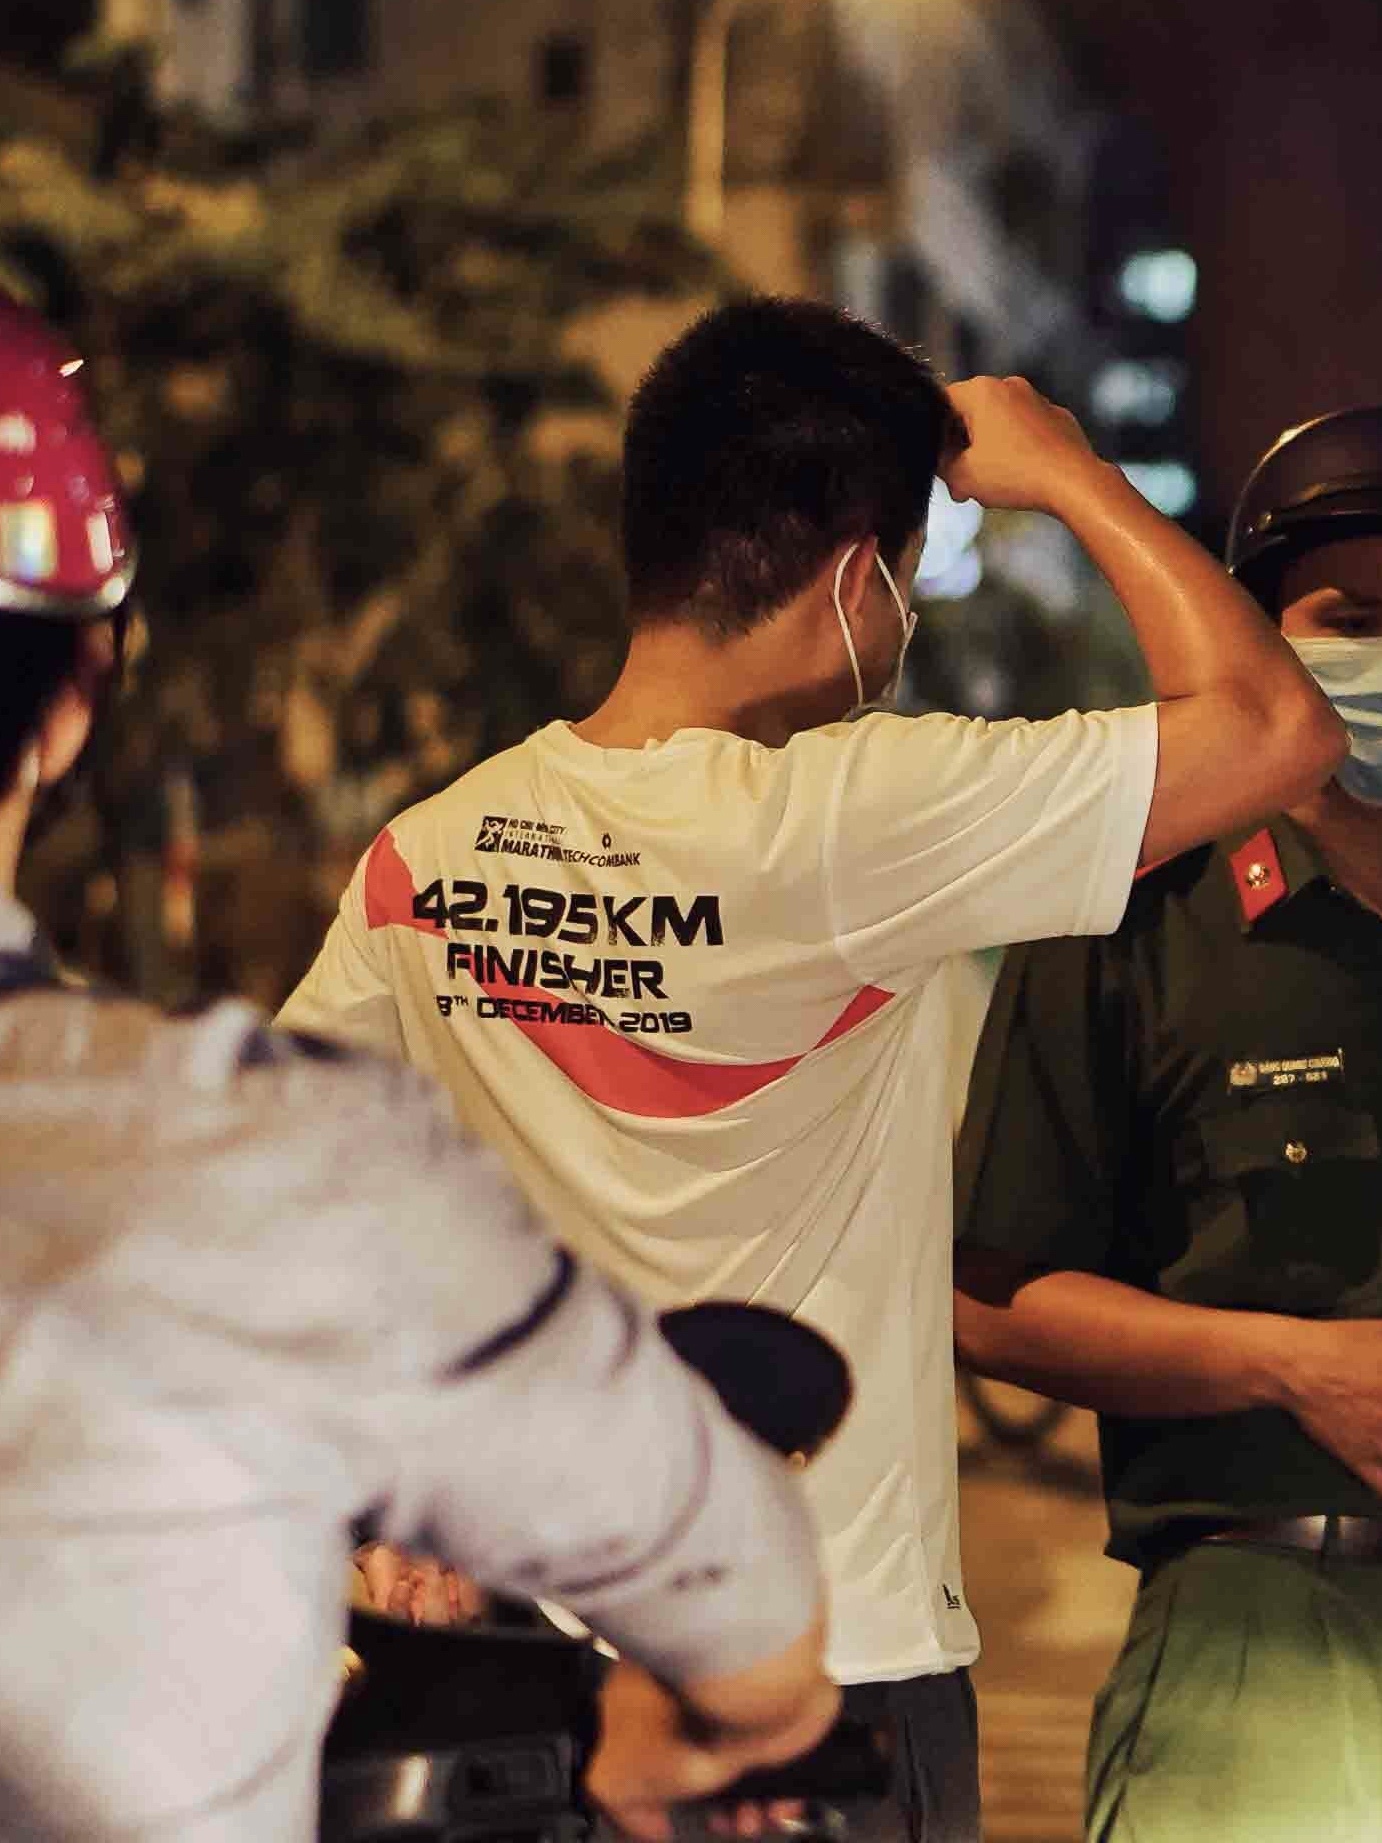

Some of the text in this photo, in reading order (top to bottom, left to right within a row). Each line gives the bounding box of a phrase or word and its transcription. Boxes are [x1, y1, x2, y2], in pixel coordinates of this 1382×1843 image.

[563, 849, 642, 868] TECHCOMBANK
[412, 879, 724, 947] 42.195KM
[446, 943, 669, 1000] FINISHER
[619, 1010, 693, 1034] 2019
